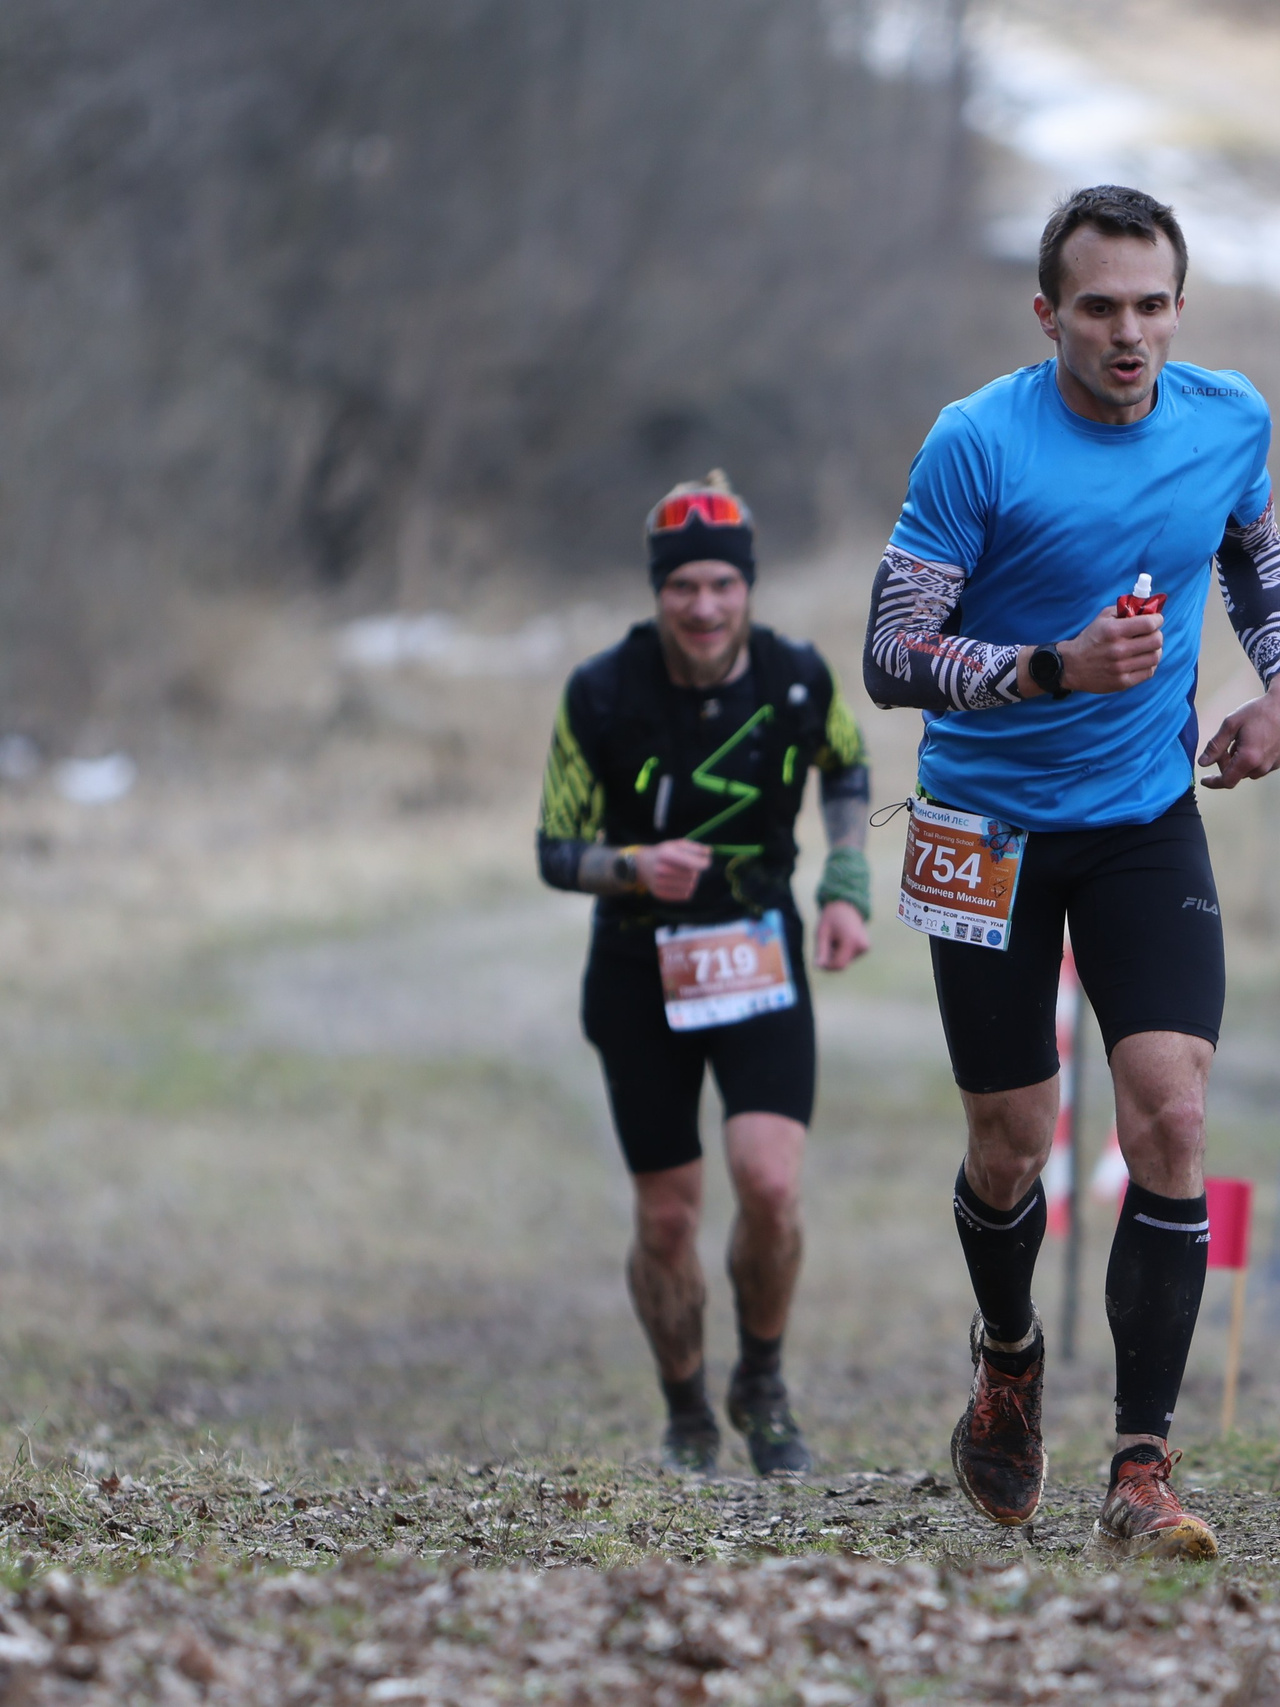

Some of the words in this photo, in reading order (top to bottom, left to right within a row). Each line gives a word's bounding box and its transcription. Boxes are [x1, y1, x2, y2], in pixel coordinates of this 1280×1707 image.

[1181, 384, 1249, 399] DIADORA
[951, 816, 970, 827] ЛЕС
[923, 830, 935, 840] Trail
[935, 832, 956, 845] Running
[955, 837, 975, 848] School
[914, 838, 982, 890] 754
[956, 891, 997, 908] Михаил
[1181, 896, 1219, 916] FILA
[689, 943, 758, 983] 719
